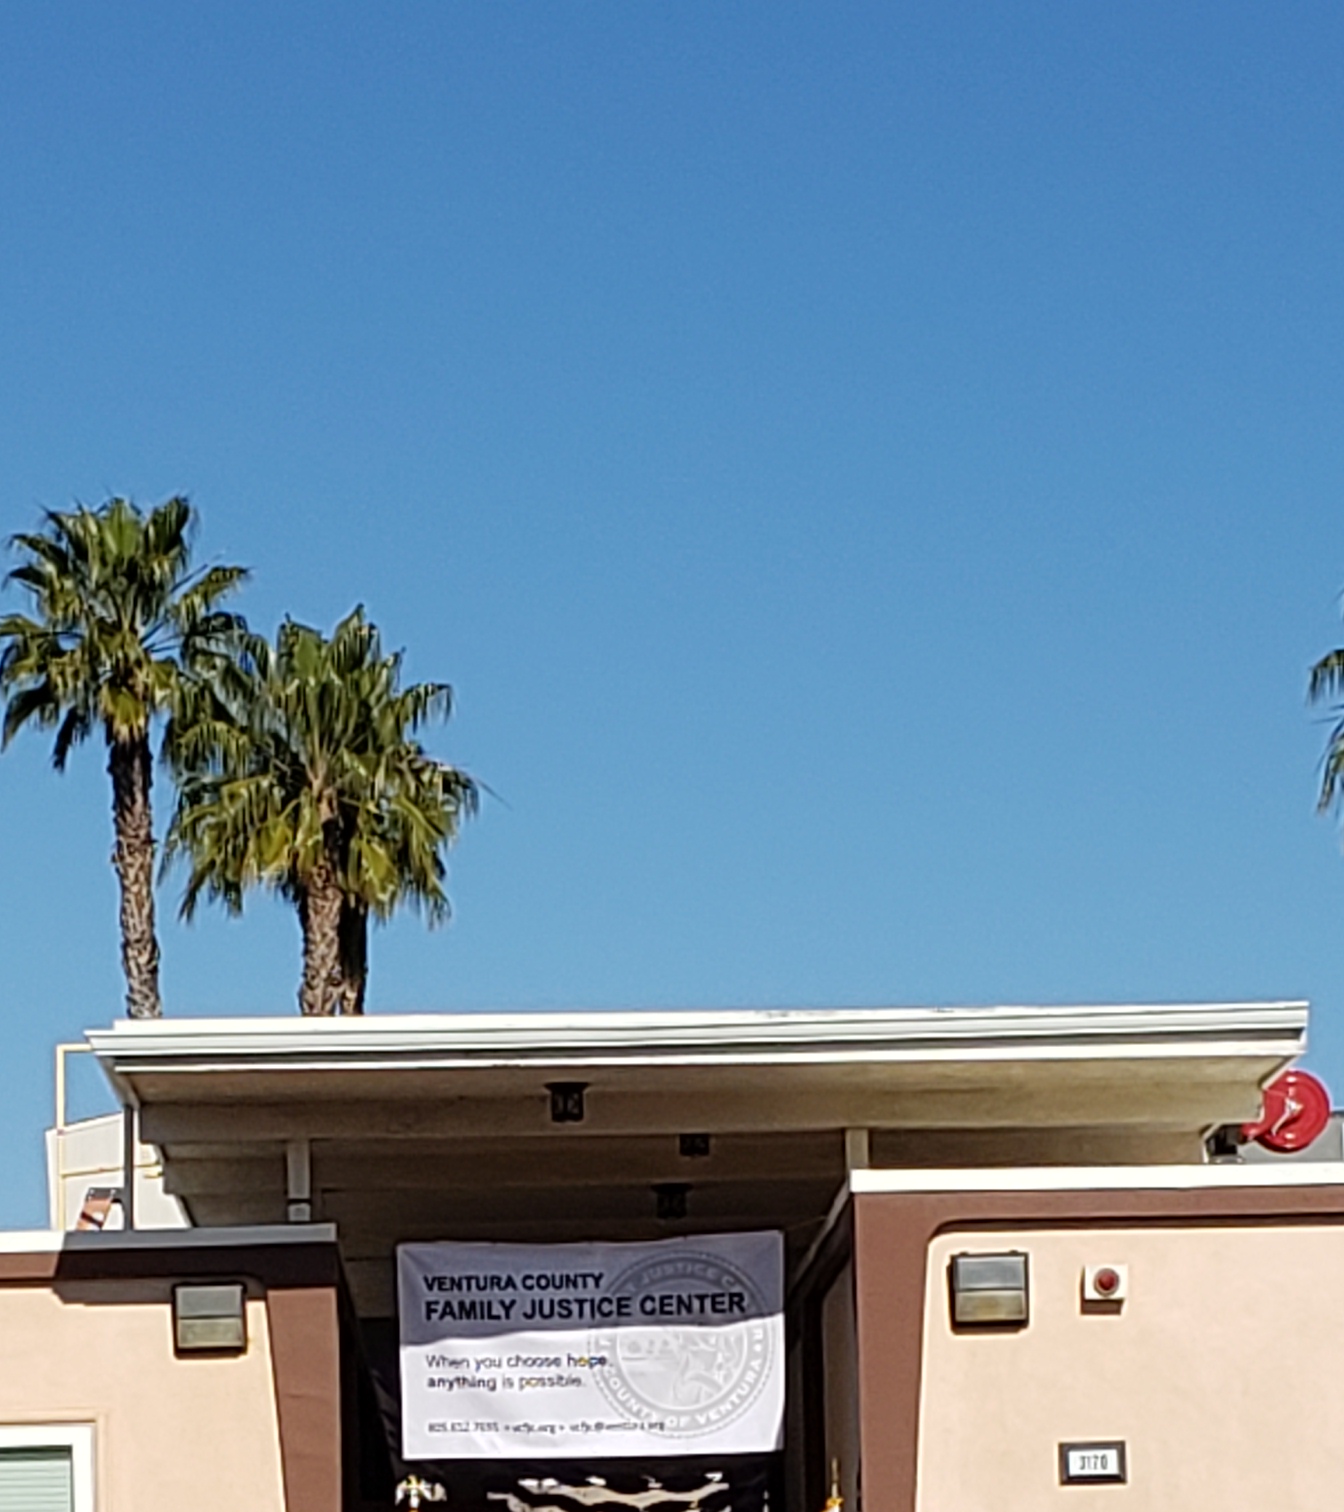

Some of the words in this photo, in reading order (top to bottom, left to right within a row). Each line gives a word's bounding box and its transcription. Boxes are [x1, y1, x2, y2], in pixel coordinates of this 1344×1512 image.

[423, 1275, 517, 1292] VENTURA
[521, 1272, 604, 1291] COUNTY
[425, 1299, 517, 1321] FAMILY
[522, 1296, 632, 1320] JUSTICE
[640, 1292, 747, 1316] CENTER
[426, 1355, 470, 1368] When
[475, 1356, 502, 1371] you
[507, 1355, 562, 1368] choose
[427, 1375, 497, 1391] anything
[503, 1374, 514, 1387] is
[694, 1358, 762, 1425] VENTURA
